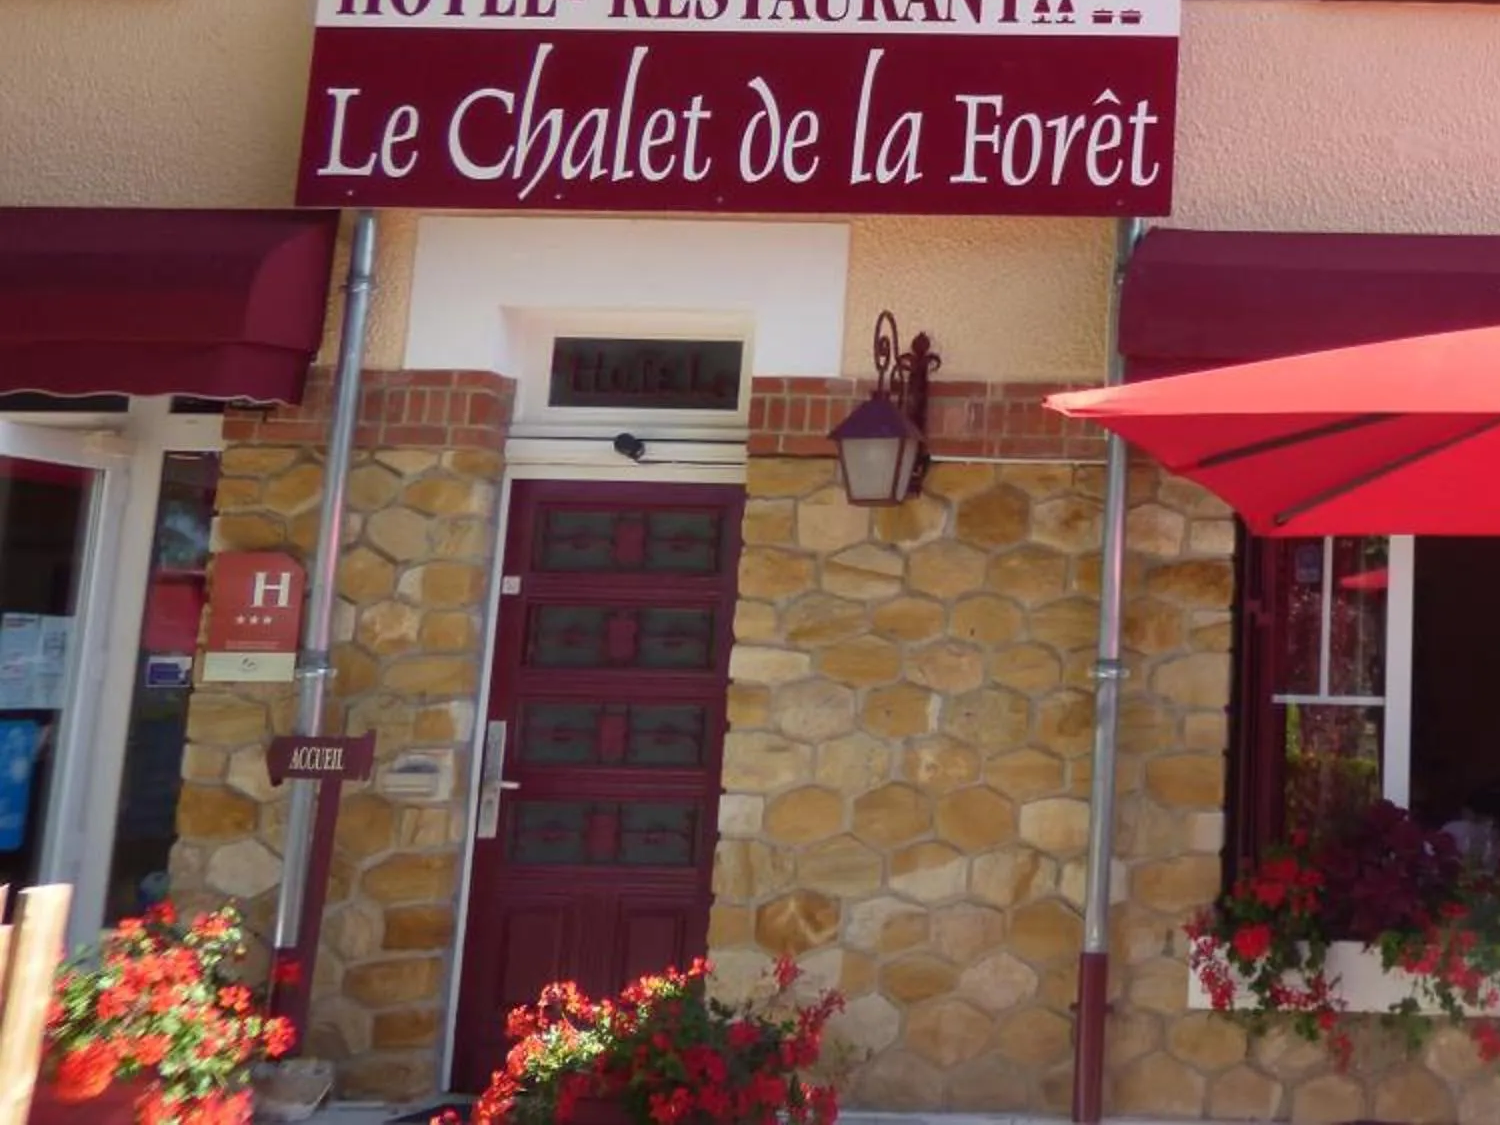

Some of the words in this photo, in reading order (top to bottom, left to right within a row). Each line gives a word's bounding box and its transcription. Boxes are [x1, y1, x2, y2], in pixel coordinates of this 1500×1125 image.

[316, 88, 419, 178] Le
[447, 42, 712, 199] Chalet
[738, 76, 819, 183] de
[849, 48, 923, 185] la
[948, 89, 1160, 187] Forêt
[251, 571, 291, 608] H
[289, 746, 345, 771] ACCUEIL
